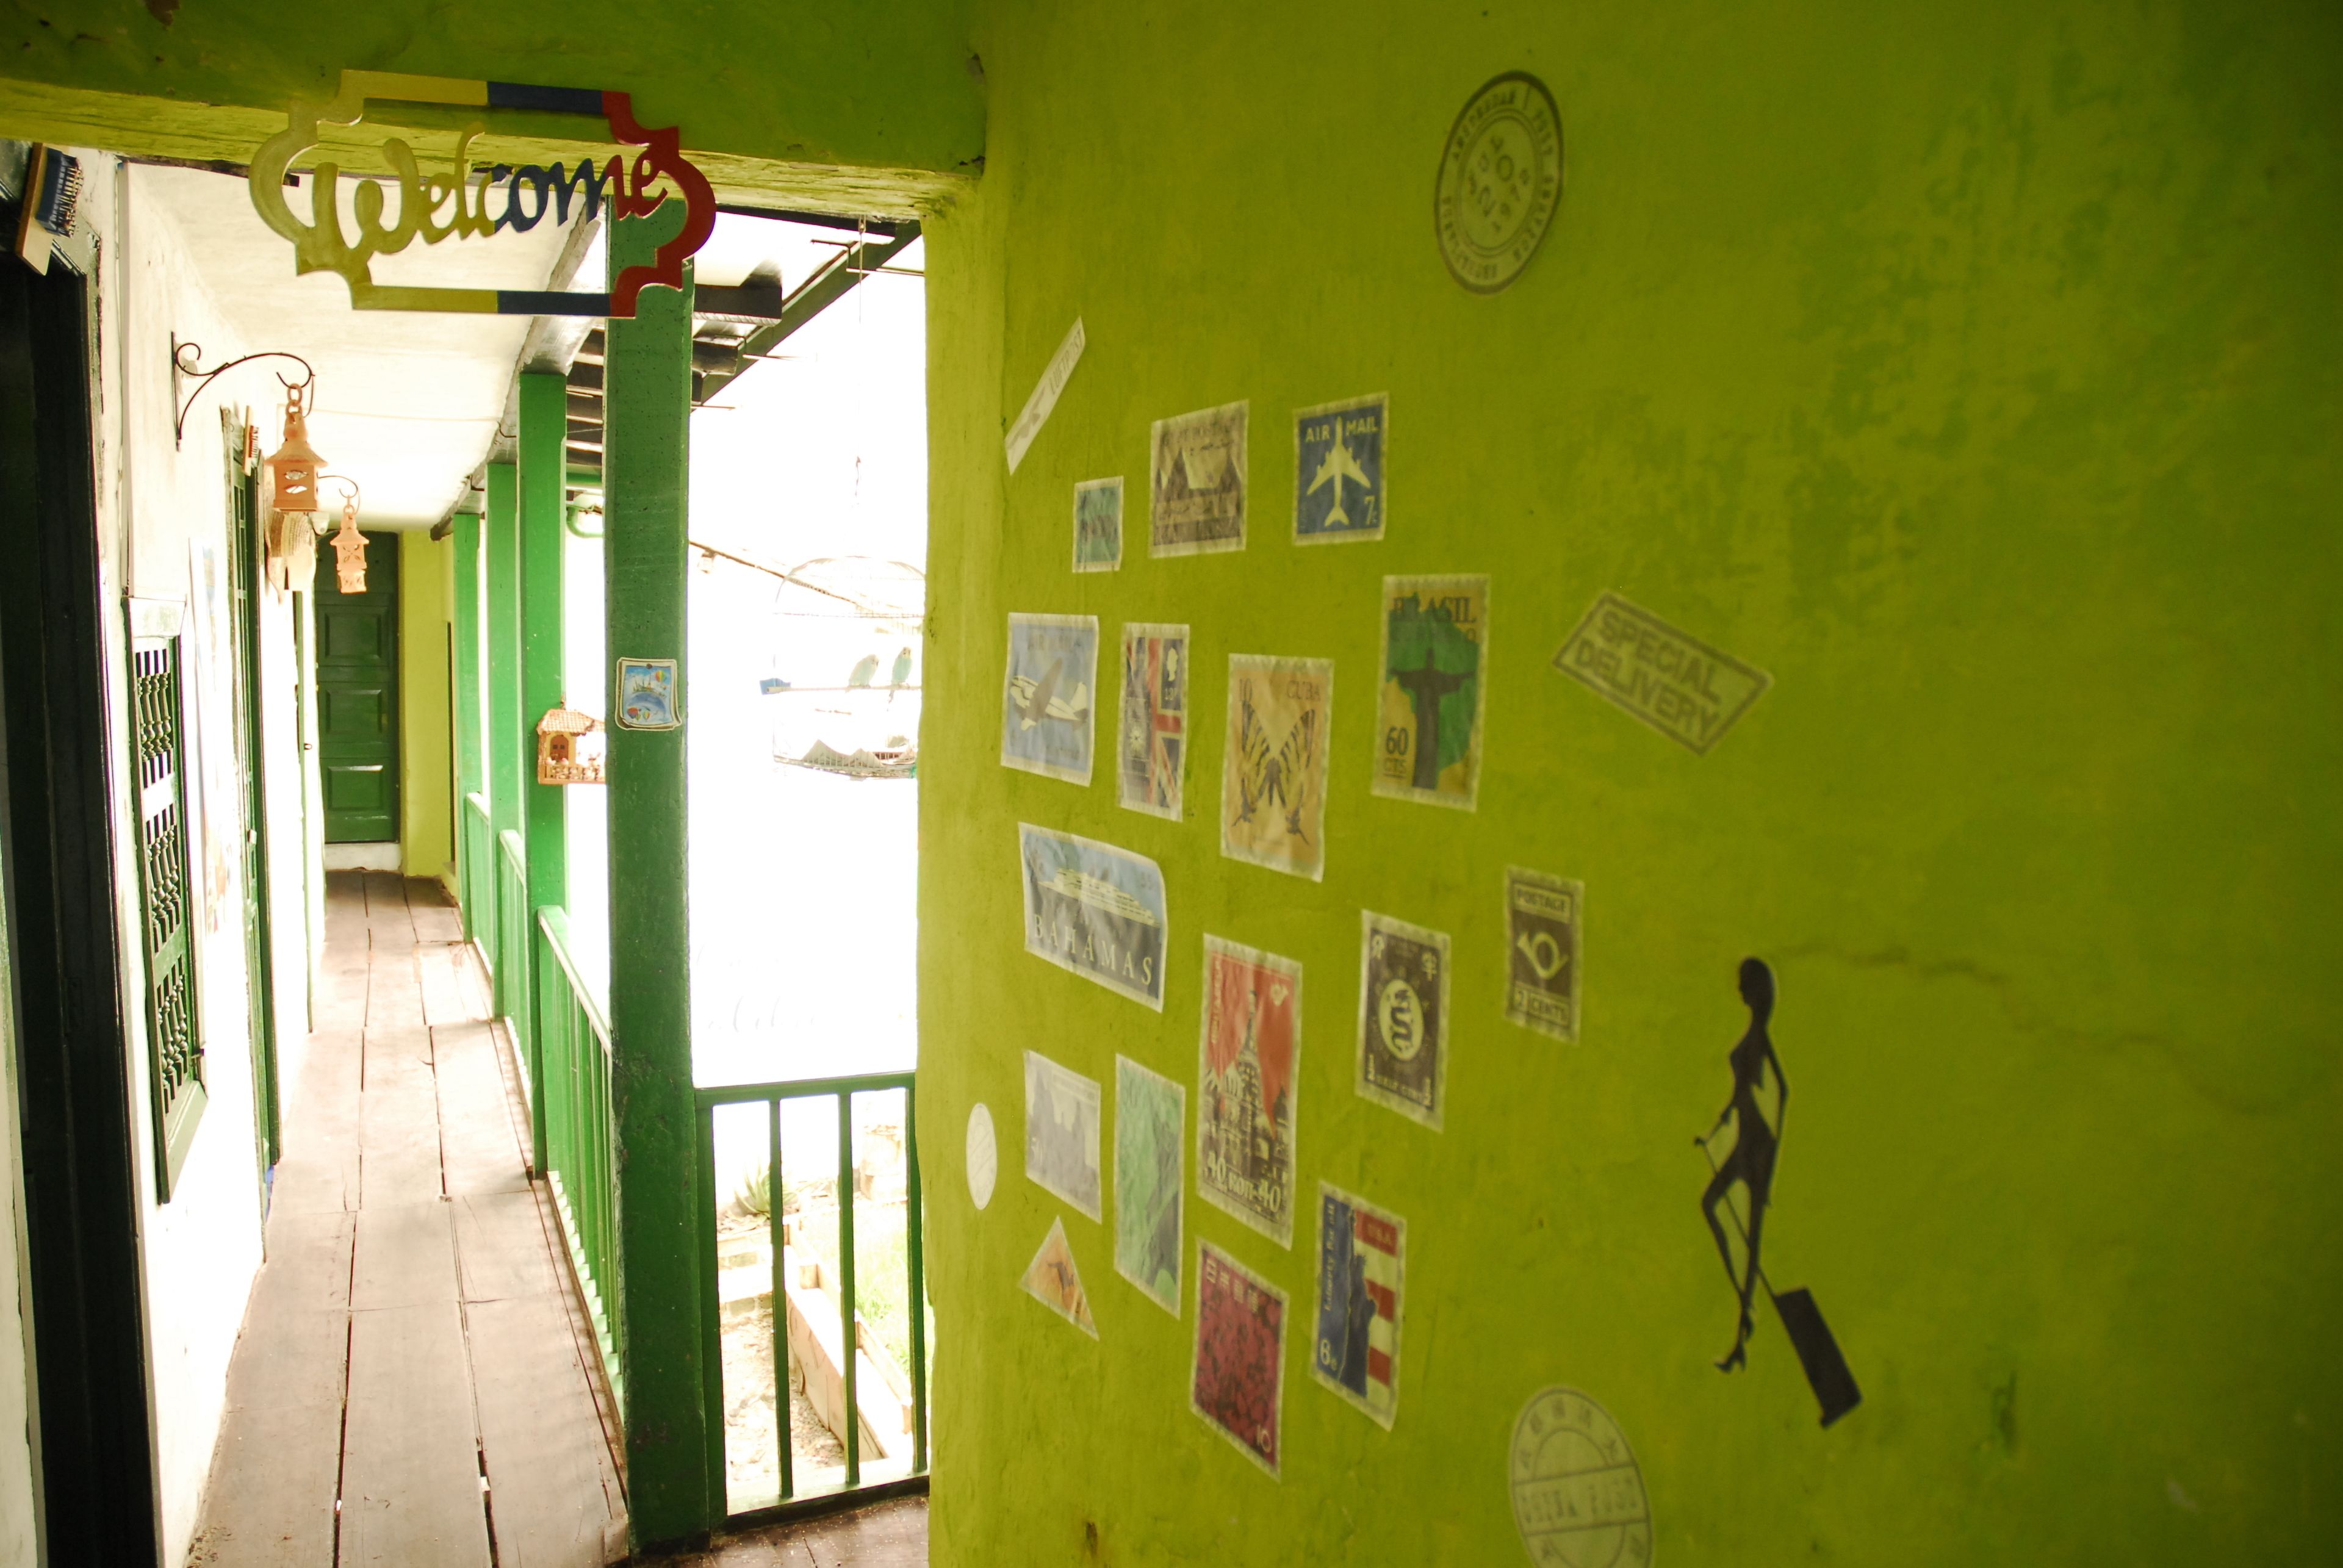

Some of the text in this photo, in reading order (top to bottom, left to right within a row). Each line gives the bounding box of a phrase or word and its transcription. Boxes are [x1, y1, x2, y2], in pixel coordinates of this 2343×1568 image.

[312, 123, 668, 254] Welcome
[1048, 328, 1083, 395] LUFTPOST
[1305, 416, 1379, 443] AIR MAIL
[1392, 594, 1477, 624] BRASIL
[1597, 611, 1721, 705] SPECIAL
[1286, 679, 1321, 701] CUBA
[1574, 638, 1719, 742] DELIVERY
[1386, 726, 1409, 755] 60
[1383, 756, 1407, 774] CTS
[1516, 888, 1566, 913] POSTAGE
[1034, 914, 1152, 986] BAHAMAS
[1207, 1151, 1226, 1184] 40
[1259, 1178, 1281, 1213] 40
